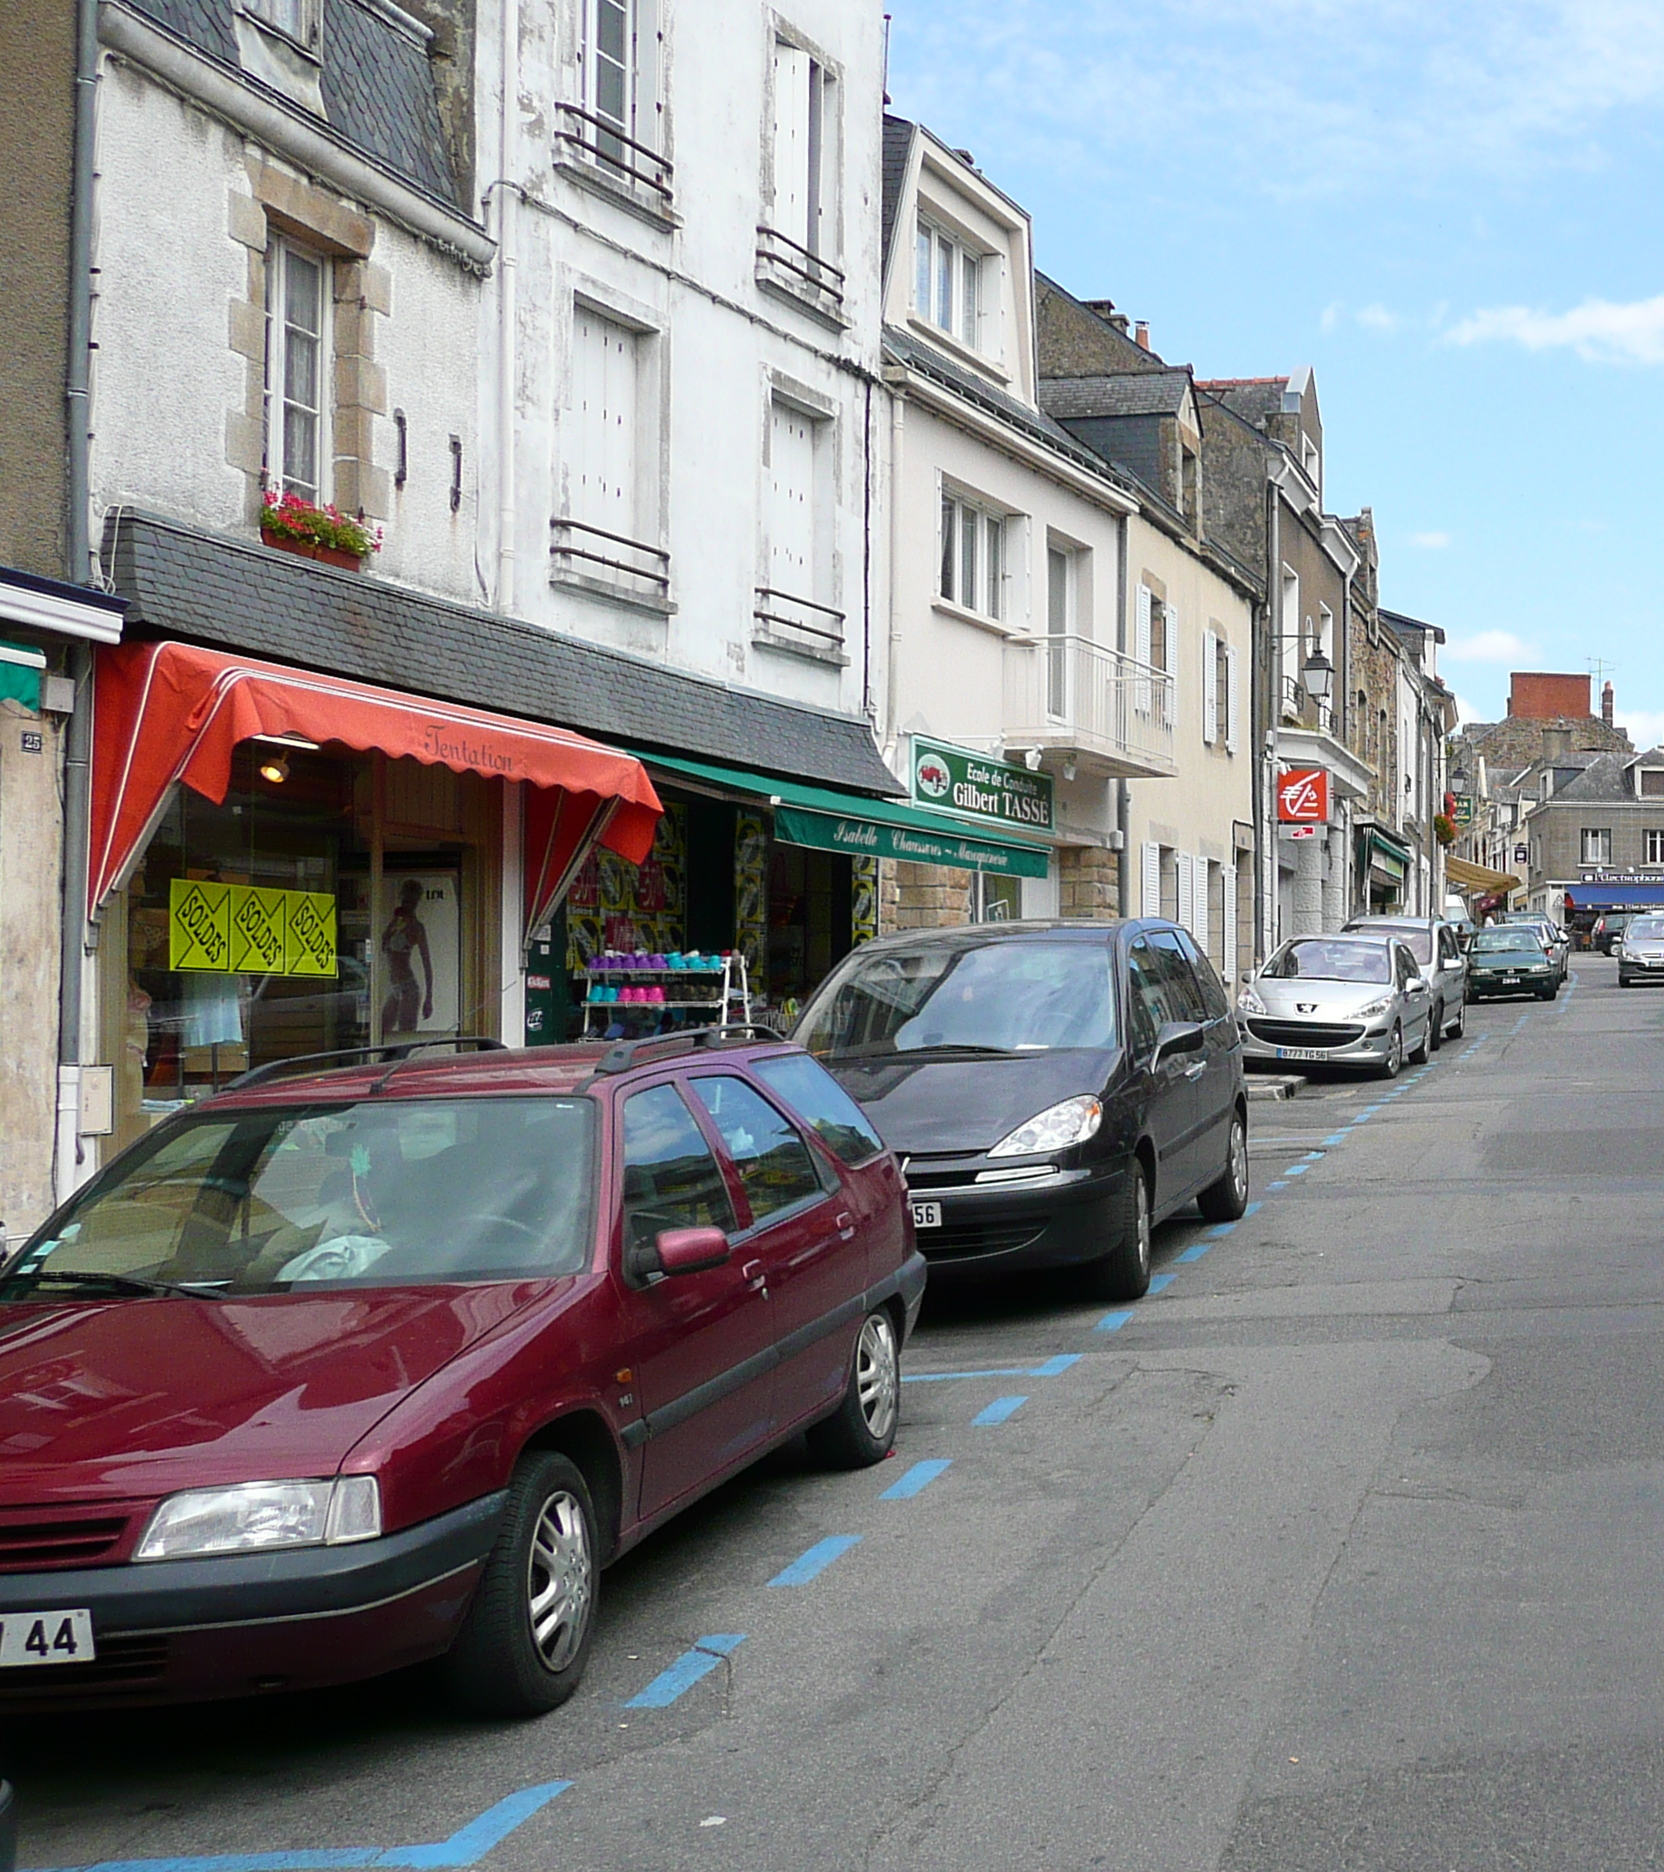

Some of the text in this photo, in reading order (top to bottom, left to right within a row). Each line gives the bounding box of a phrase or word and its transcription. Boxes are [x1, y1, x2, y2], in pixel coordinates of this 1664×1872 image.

[25, 735, 40, 750] 25
[423, 726, 513, 772] Tentation
[967, 762, 990, 784] Ecole
[992, 770, 1002, 787] de
[953, 782, 1049, 824] Gilbert TASSÉ
[181, 895, 226, 964] SOLDES
[240, 901, 282, 968] SOLDES
[295, 906, 334, 970] SOLDES
[914, 1205, 934, 1224] 56
[25, 1617, 78, 1656] 44
